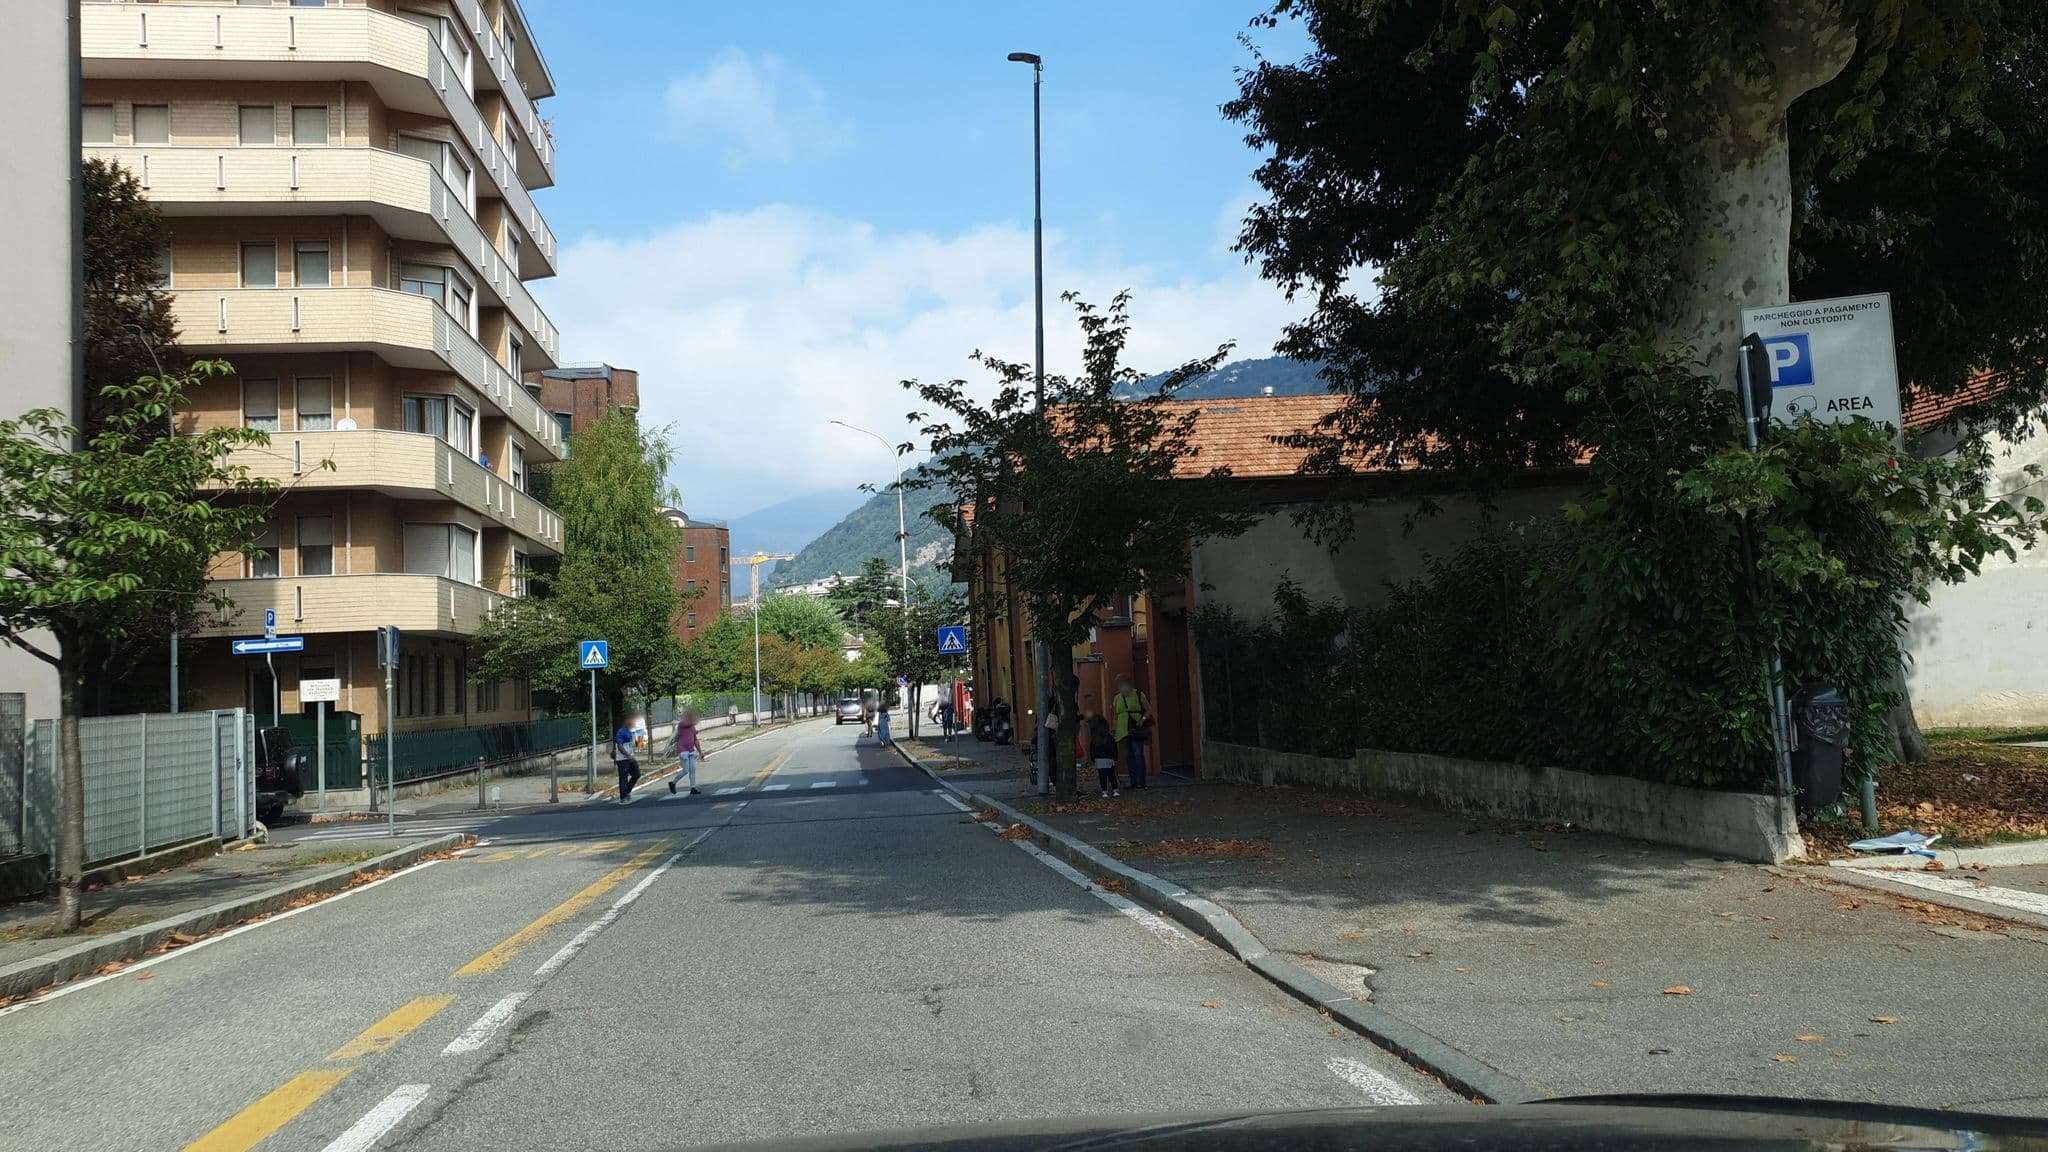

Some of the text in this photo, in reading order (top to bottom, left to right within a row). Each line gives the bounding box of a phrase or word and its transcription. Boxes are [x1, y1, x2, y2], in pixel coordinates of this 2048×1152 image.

[1753, 309, 1812, 322] PARCHEGGIO
[1823, 301, 1881, 314] PAGAMENTO
[1780, 314, 1854, 328] NON CUSTODITO
[1766, 342, 1799, 382] P
[1826, 396, 1873, 412] AREA
[267, 612, 274, 624] P
